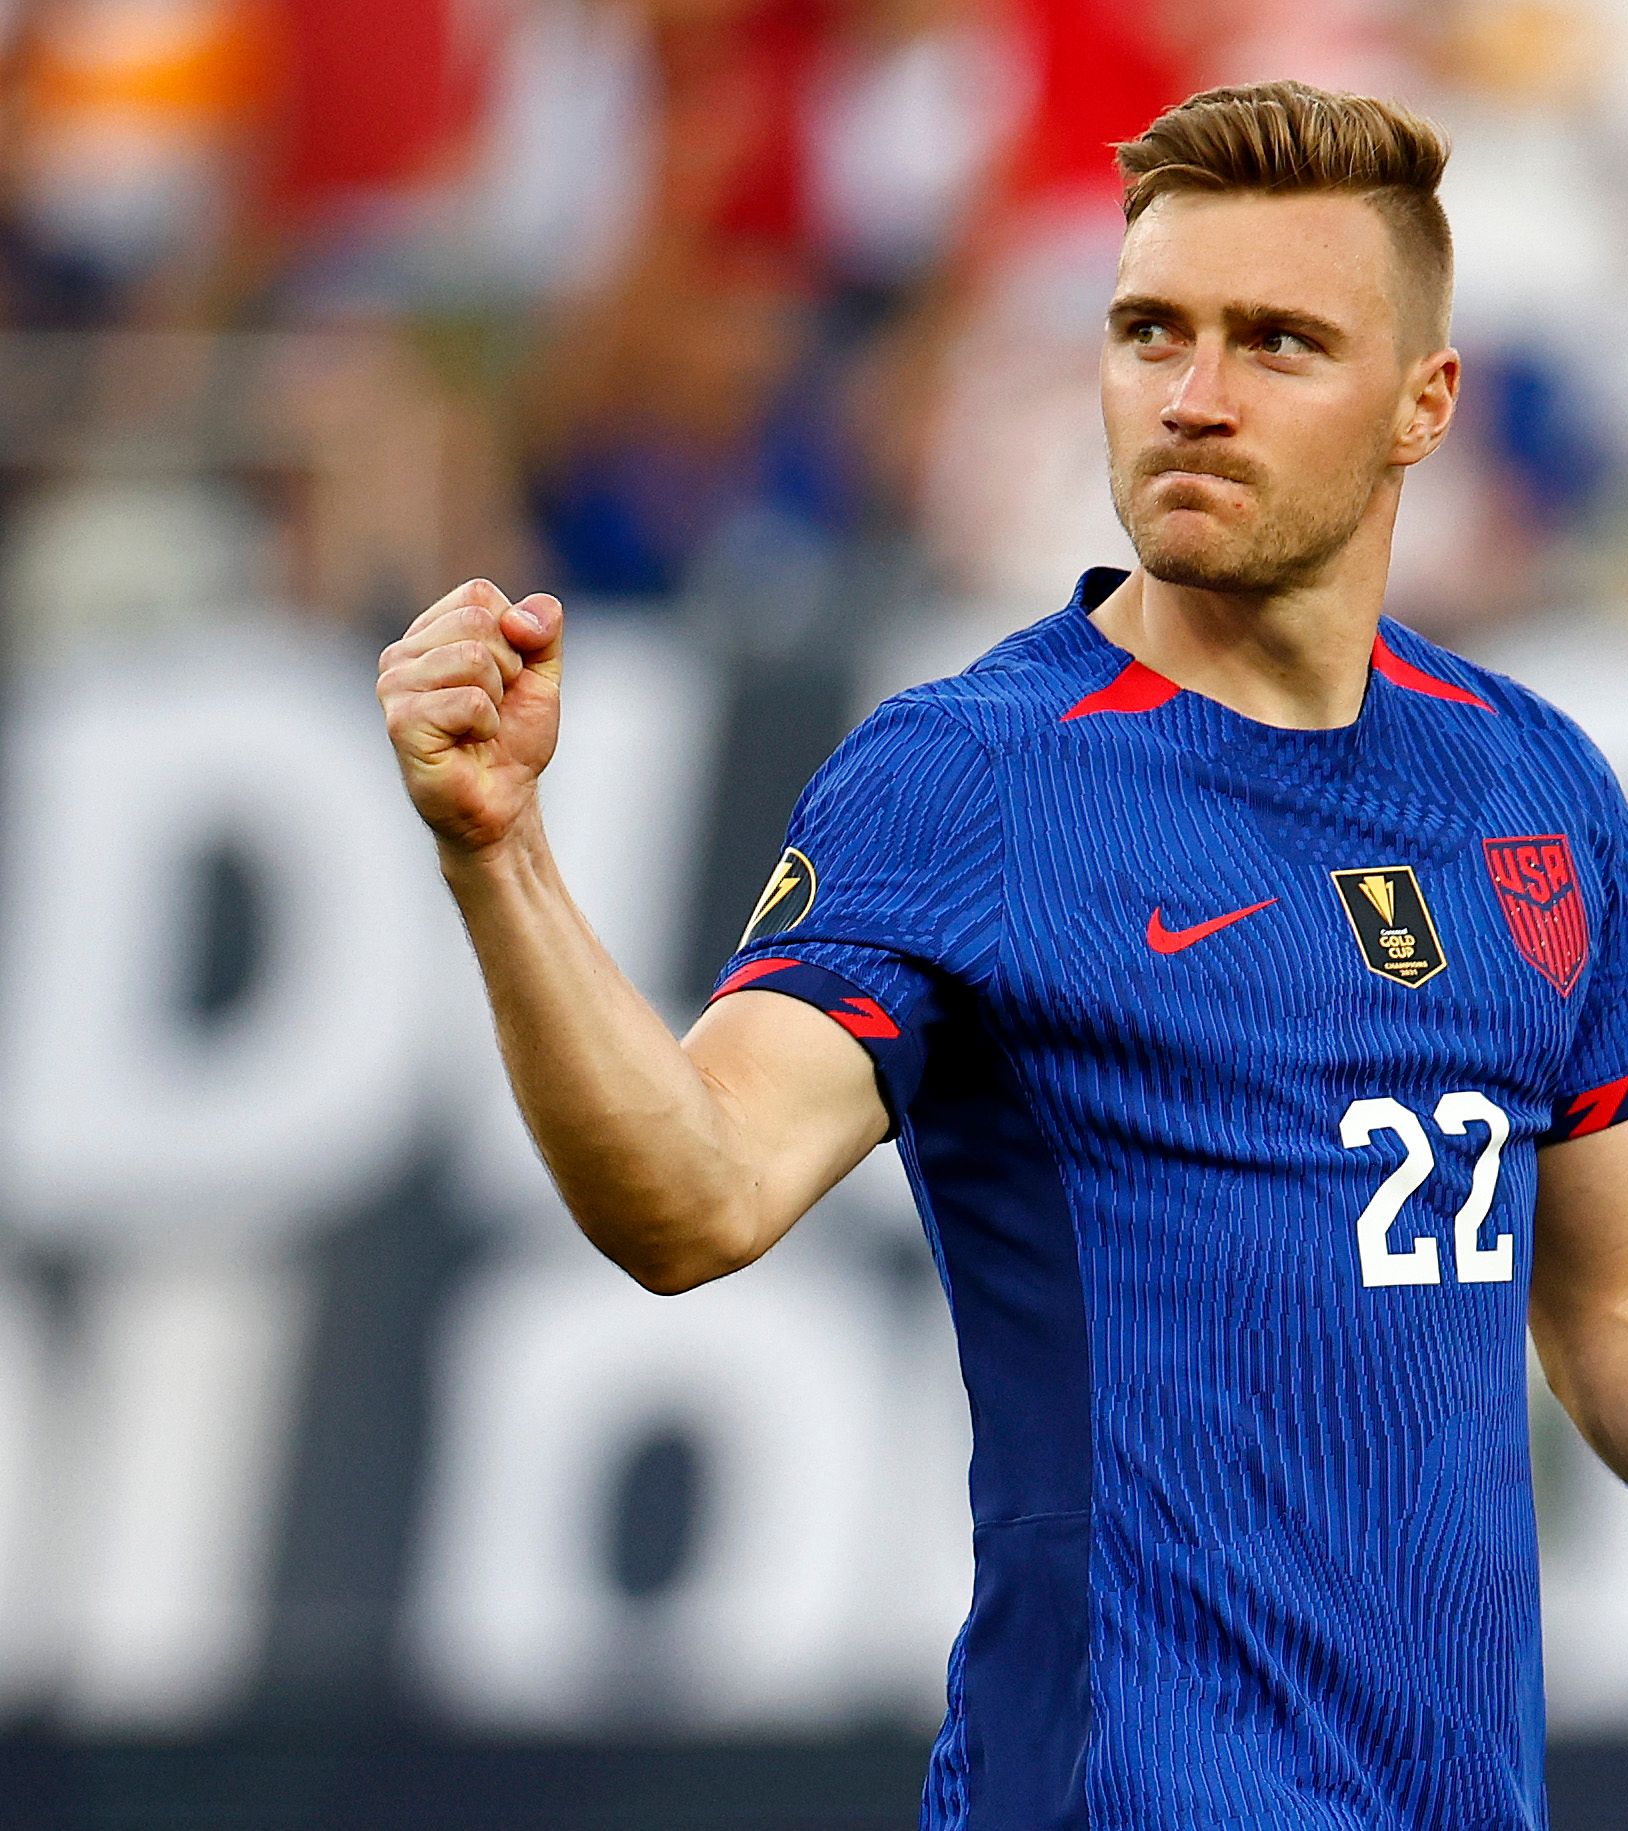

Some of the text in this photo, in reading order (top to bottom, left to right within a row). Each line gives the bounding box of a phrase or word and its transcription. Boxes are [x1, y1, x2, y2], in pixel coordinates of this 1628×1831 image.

[1490, 845, 1570, 904] USA
[1379, 934, 1415, 947] GOLD
[1388, 947, 1414, 958] CUP
[1339, 1091, 1513, 1288] 22
